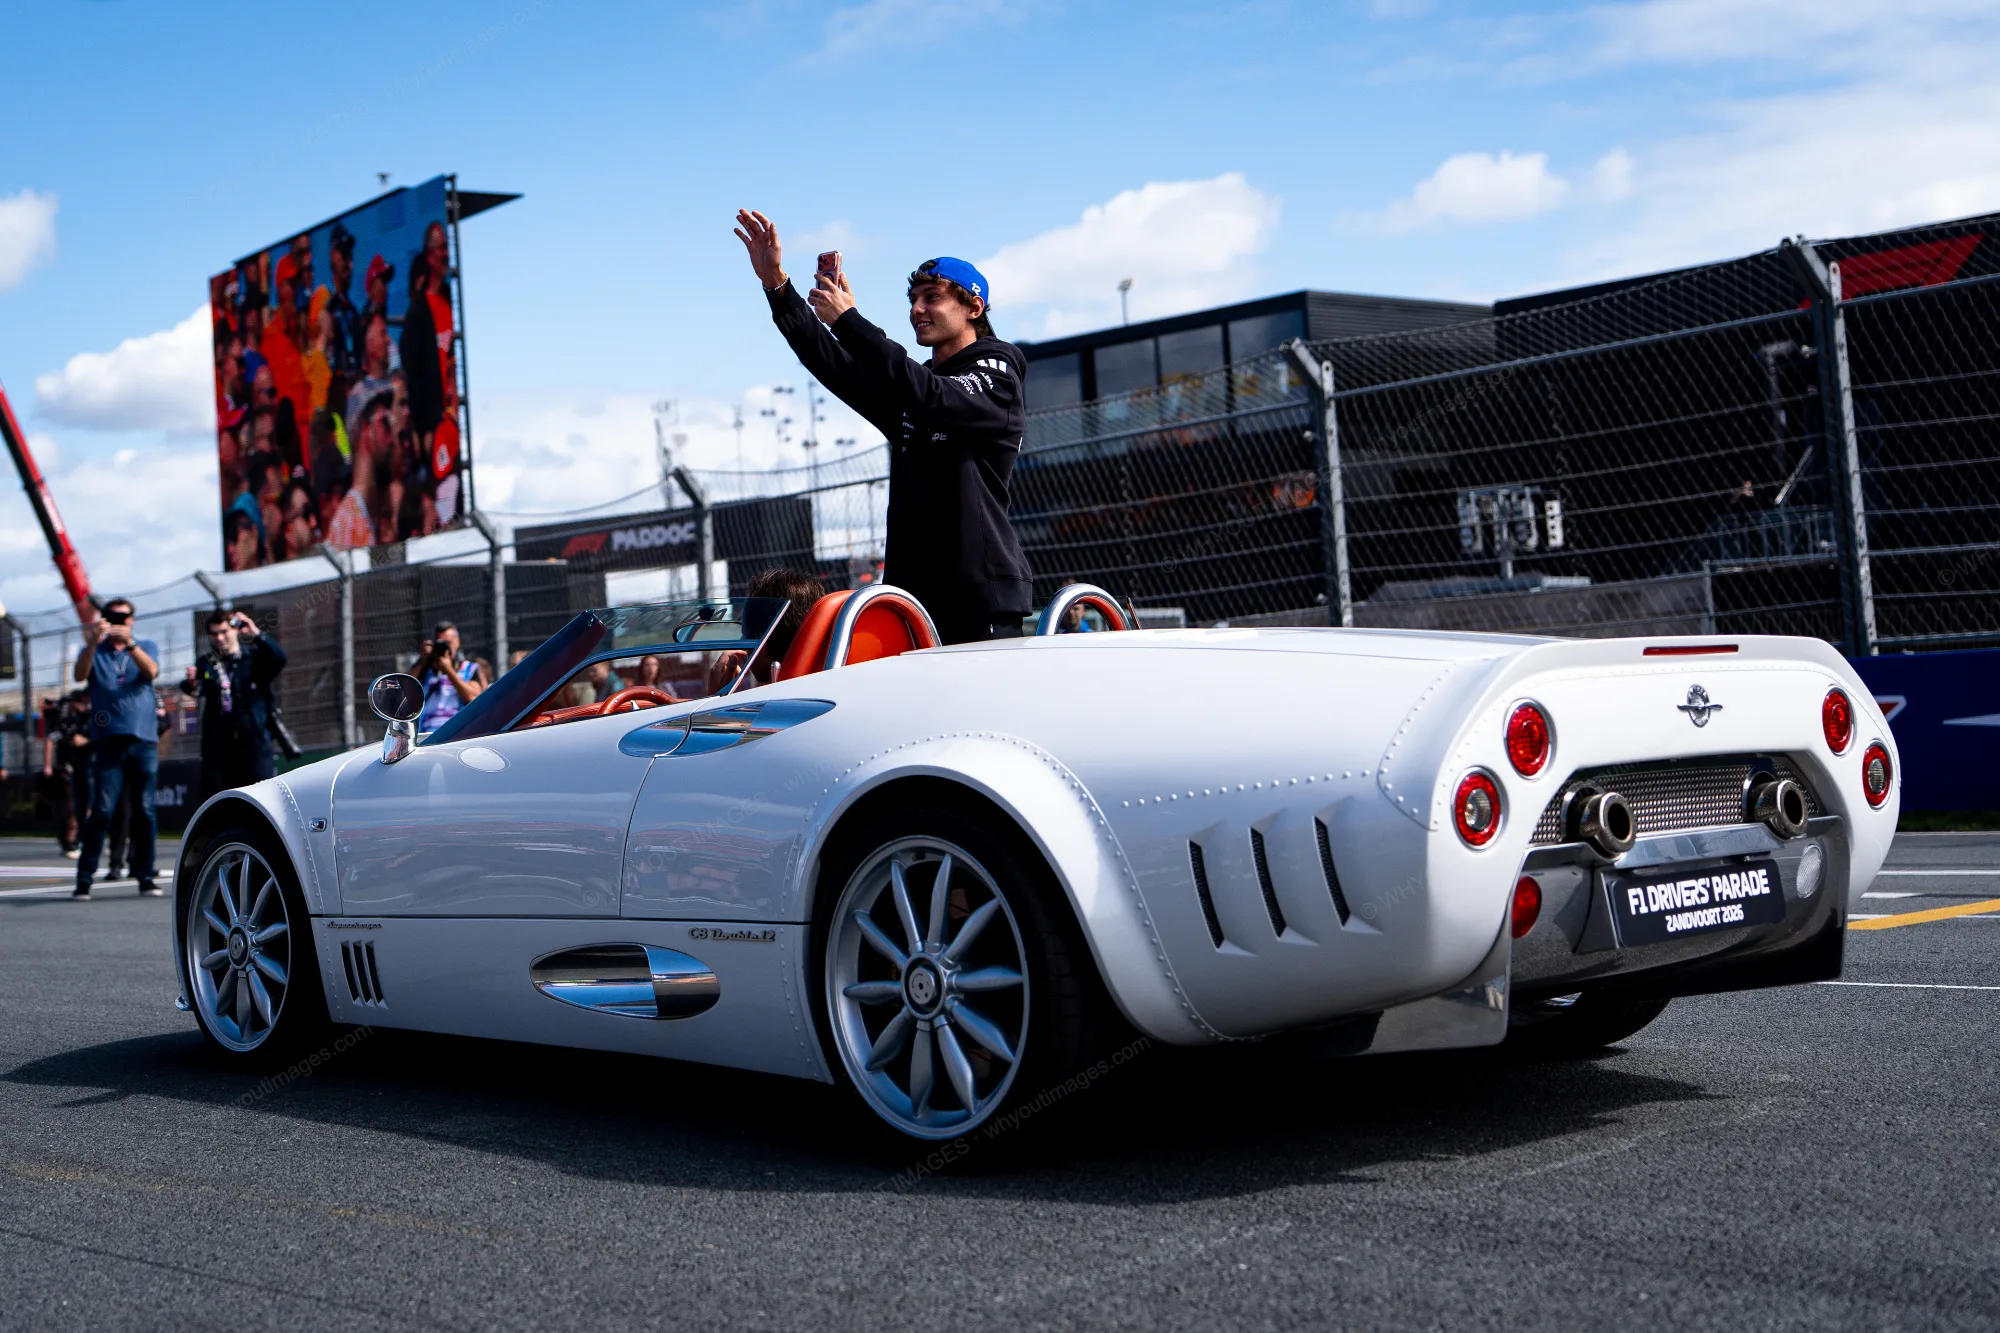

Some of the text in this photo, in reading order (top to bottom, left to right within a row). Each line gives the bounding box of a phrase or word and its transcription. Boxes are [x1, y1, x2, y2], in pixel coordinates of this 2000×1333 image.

[611, 519, 697, 552] PADDOC
[1627, 887, 1649, 915] F1
[1712, 868, 1771, 901] PARADE
[1665, 904, 1745, 933] ZANDVOORT 2026
